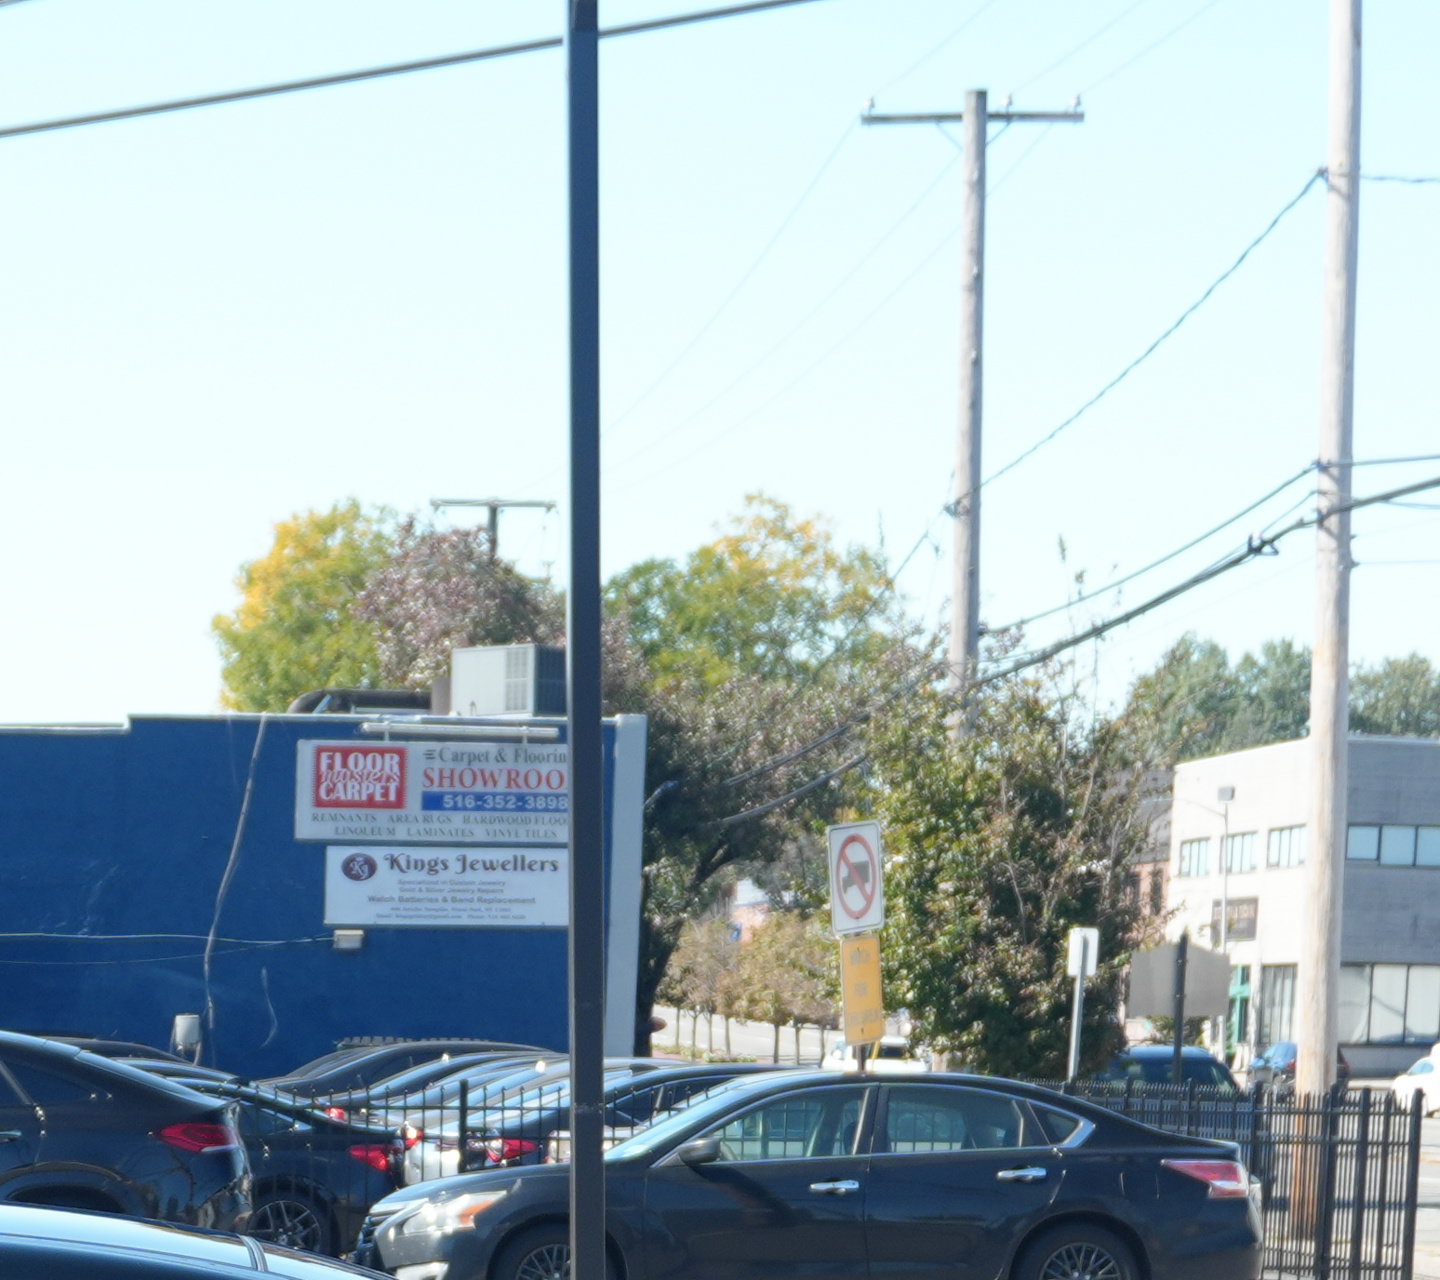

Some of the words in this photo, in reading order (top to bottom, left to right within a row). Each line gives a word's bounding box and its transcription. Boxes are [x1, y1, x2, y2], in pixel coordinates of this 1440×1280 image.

[320, 752, 400, 773] FLOOR
[439, 747, 489, 764] Carpet
[494, 748, 507, 763] &
[514, 748, 567, 763] Floorin
[422, 766, 566, 790] SHOWROO
[319, 780, 400, 801] CARPET
[312, 812, 377, 823] REMNANTS
[533, 815, 567, 826] FLOO
[407, 827, 474, 838] LAMINATES
[383, 853, 449, 876] Kings
[454, 853, 559, 875] Jewellers
